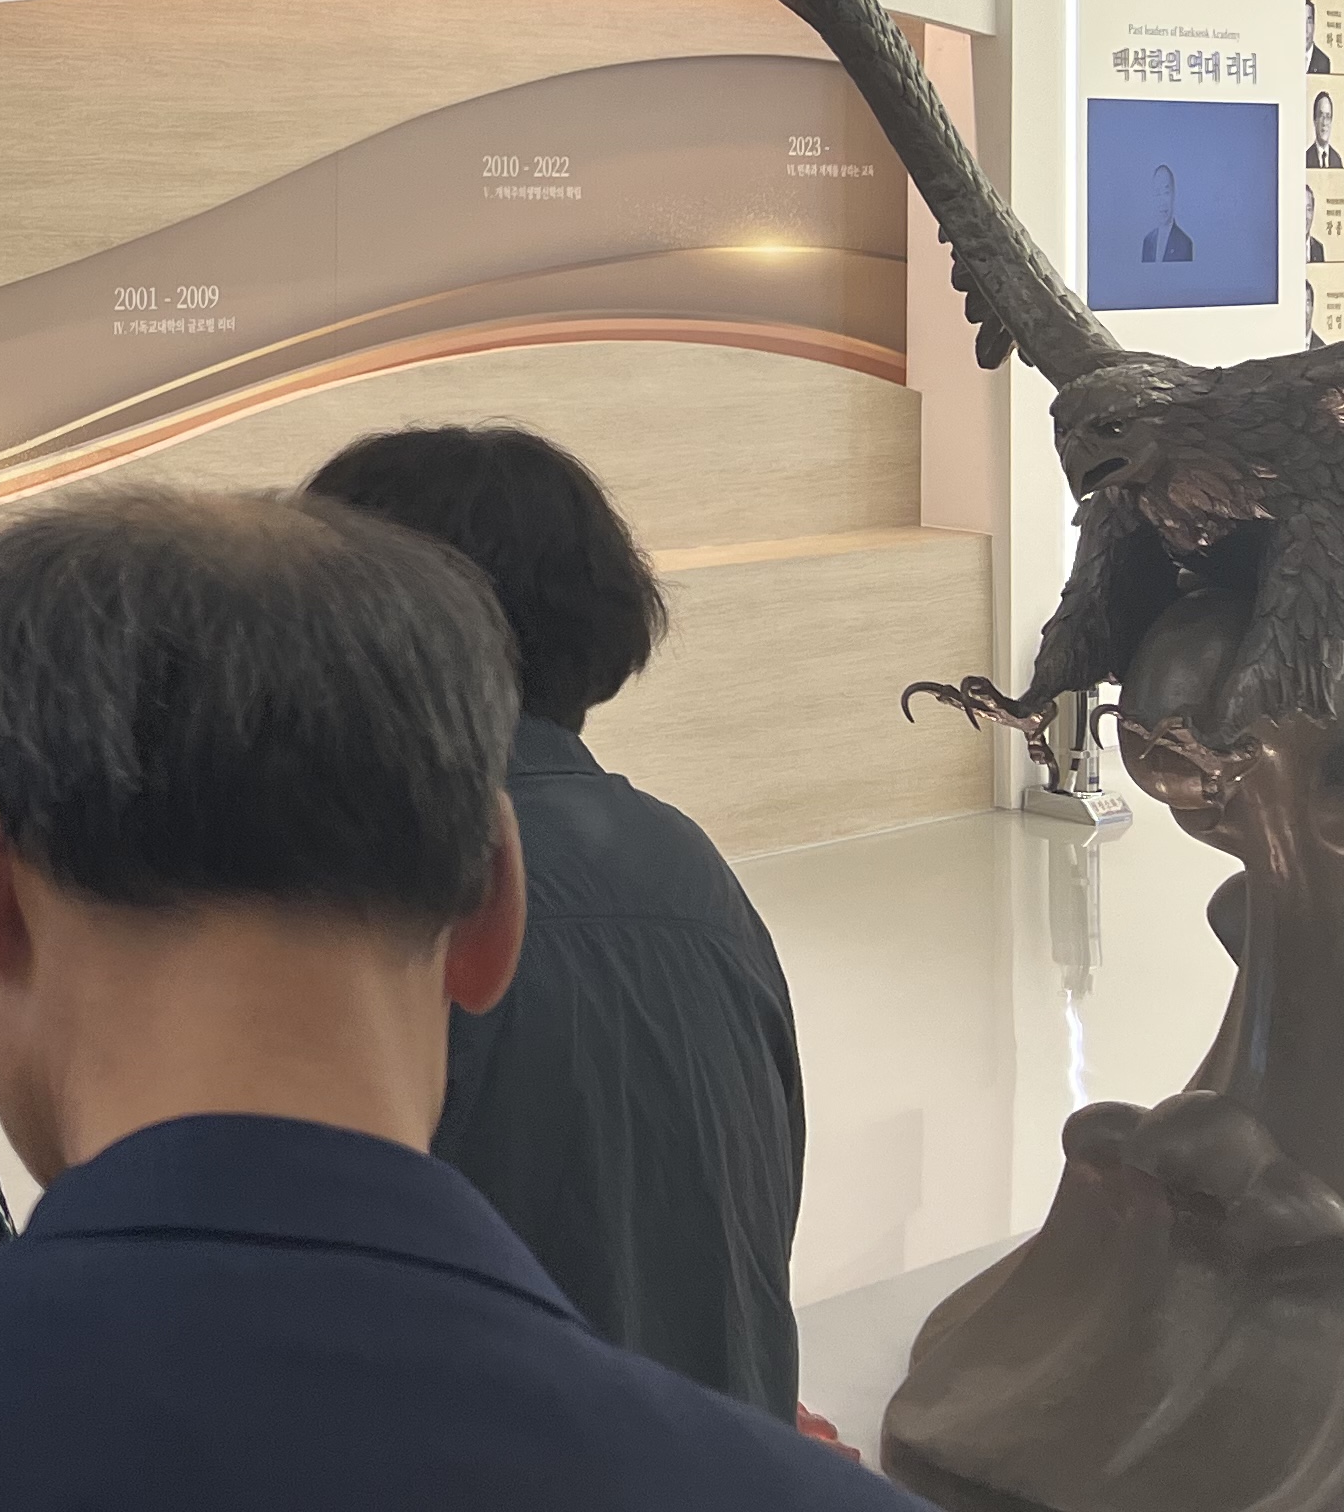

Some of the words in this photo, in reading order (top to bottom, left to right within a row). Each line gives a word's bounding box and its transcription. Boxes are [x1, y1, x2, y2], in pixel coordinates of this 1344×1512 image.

[1128, 24, 1142, 35] Past
[1145, 24, 1168, 36] leaders
[1170, 26, 1178, 36] of
[1212, 28, 1240, 42] Academy
[1112, 47, 1182, 82] 백석학원
[1187, 50, 1220, 84] 역대
[1226, 52, 1257, 84] 리더
[788, 136, 821, 156] 2023
[482, 155, 519, 178] 2010
[533, 156, 570, 178] 2022
[114, 287, 158, 311] 2001
[176, 285, 219, 309] 2009
[129, 318, 185, 335] 기독교대학의
[187, 318, 215, 333] 글로벌
[217, 316, 236, 332] 리더
